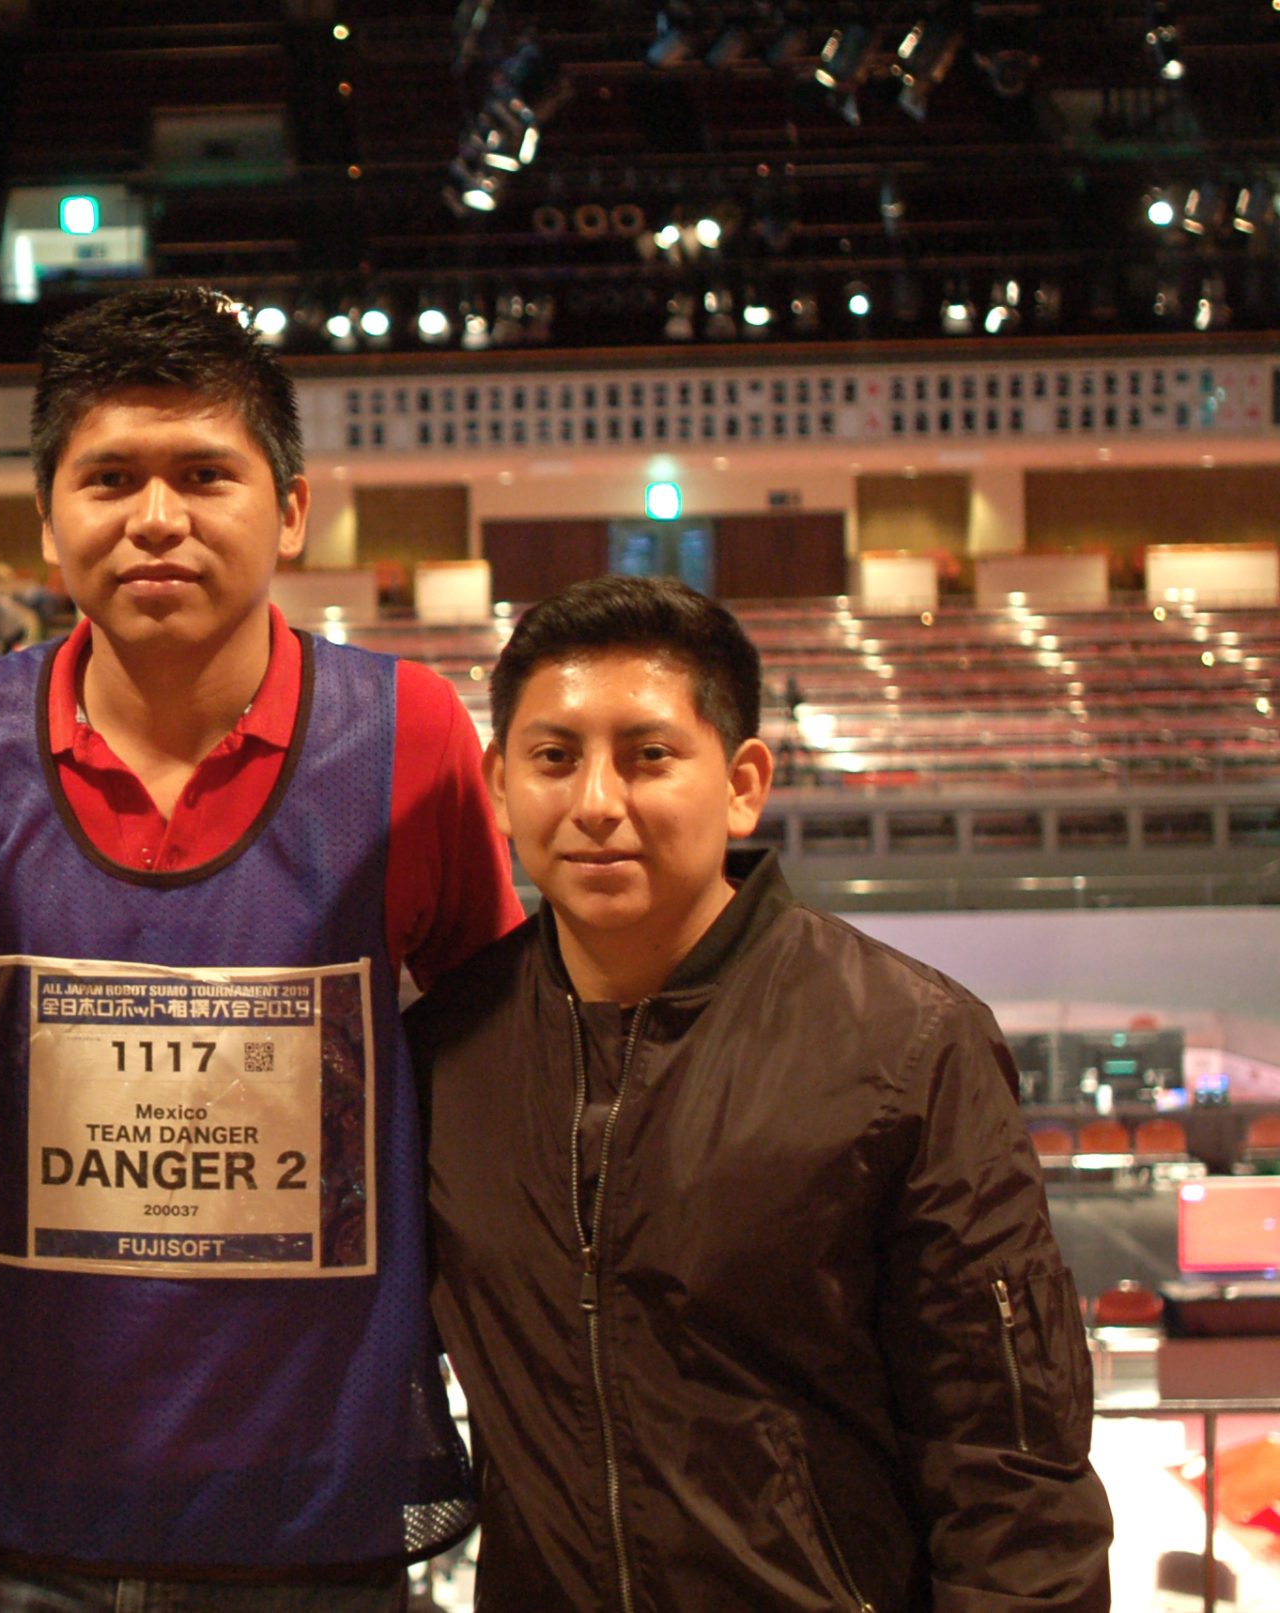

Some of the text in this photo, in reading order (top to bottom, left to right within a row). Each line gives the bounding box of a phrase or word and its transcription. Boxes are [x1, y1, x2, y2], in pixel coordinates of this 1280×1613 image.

[43, 983, 309, 997] ALL JAPAN ROBOT SUMO TOURNAMENT 2019
[111, 1040, 217, 1072] 1117
[136, 1104, 208, 1120] Mexico
[86, 1124, 259, 1144] TEAM DANGER
[41, 1146, 307, 1190] DANGER 2
[143, 1204, 199, 1217] 200037
[118, 1238, 225, 1257] FUJISOFT
